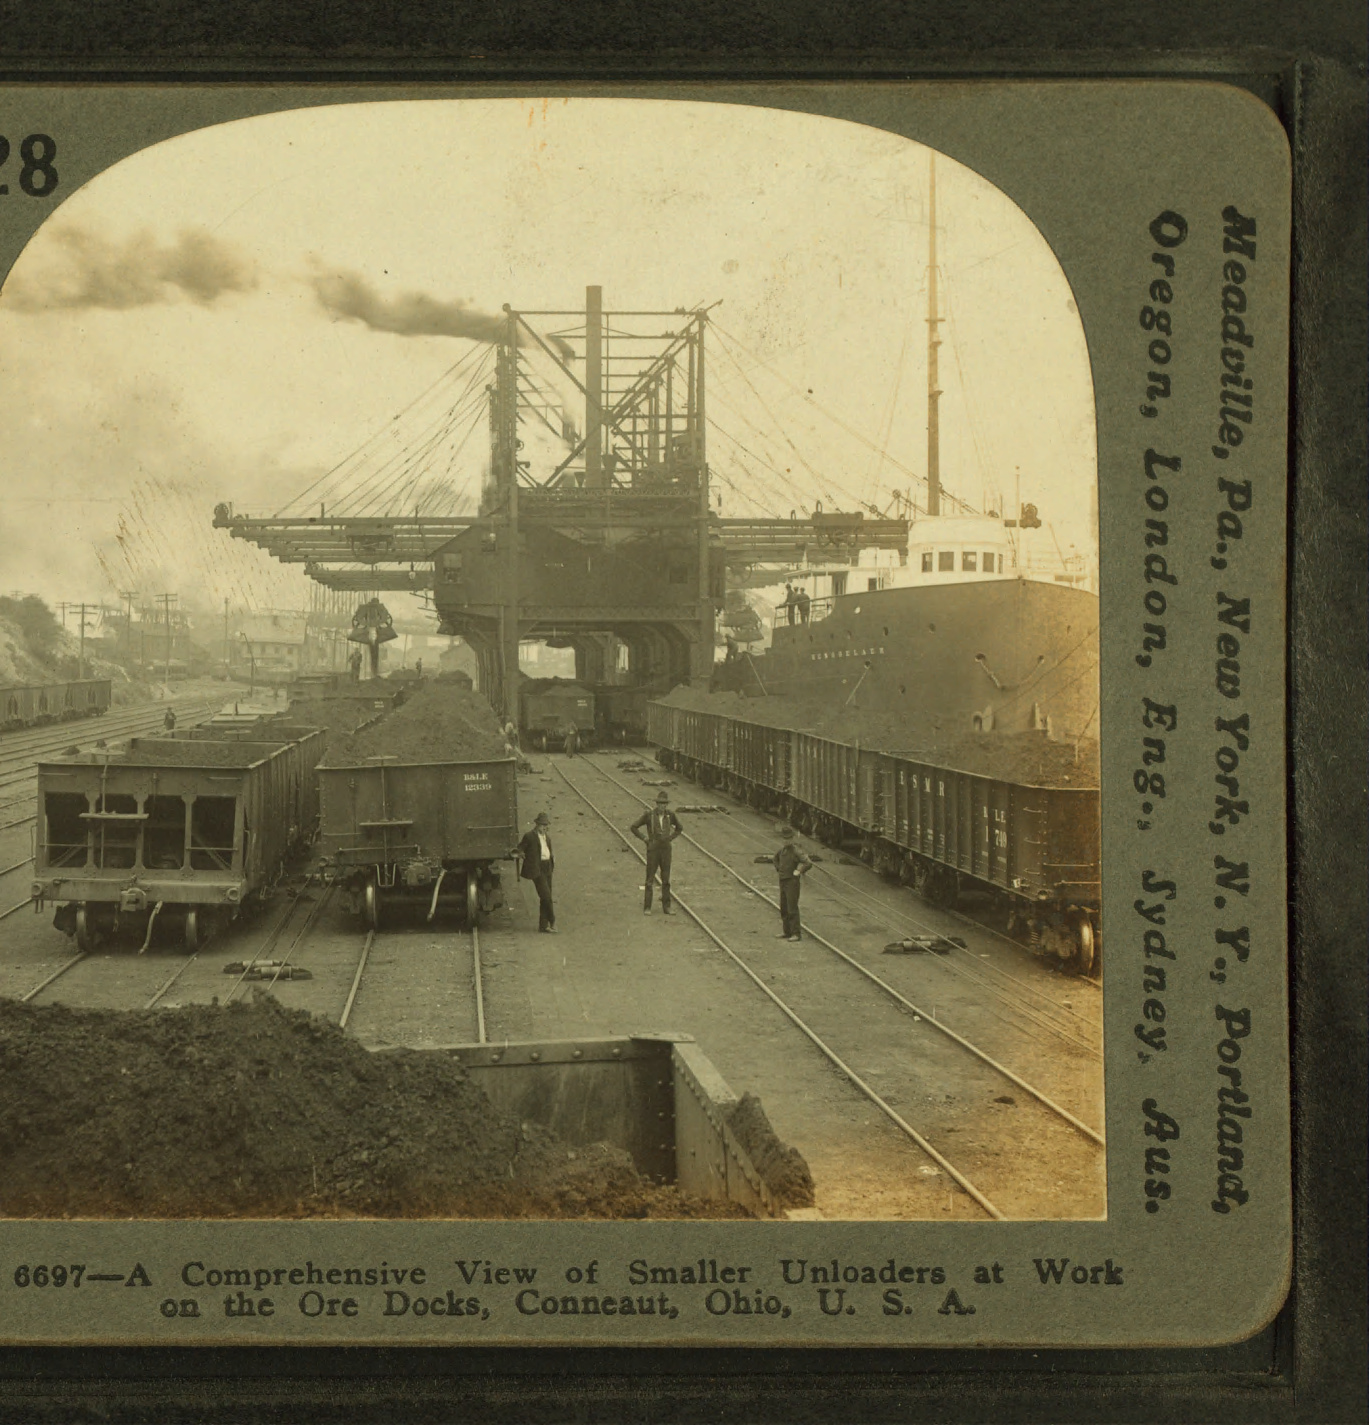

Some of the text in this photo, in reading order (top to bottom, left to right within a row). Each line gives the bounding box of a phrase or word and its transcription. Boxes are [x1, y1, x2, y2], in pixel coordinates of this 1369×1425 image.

[1139, 208, 1189, 418] Oregon,
[1135, 447, 1182, 668] London,
[1133, 697, 1178, 831] Eng.,
[1208, 205, 1257, 1215] Meadville, Pa., New York, N. Y., Portland,
[1142, 1098, 1181, 1214] Aus.
[160, 1288, 977, 1320] on the Ore Docks, Conneaut, Ohio, U. S. A.
[181, 1261, 426, 1290] Comprehensive
[454, 1260, 537, 1285] View
[565, 1260, 599, 1285] of
[629, 1259, 752, 1285] Smaller
[780, 1259, 946, 1285] Unloaders
[973, 1262, 1004, 1285] at
[1032, 1258, 1124, 1285] Work
